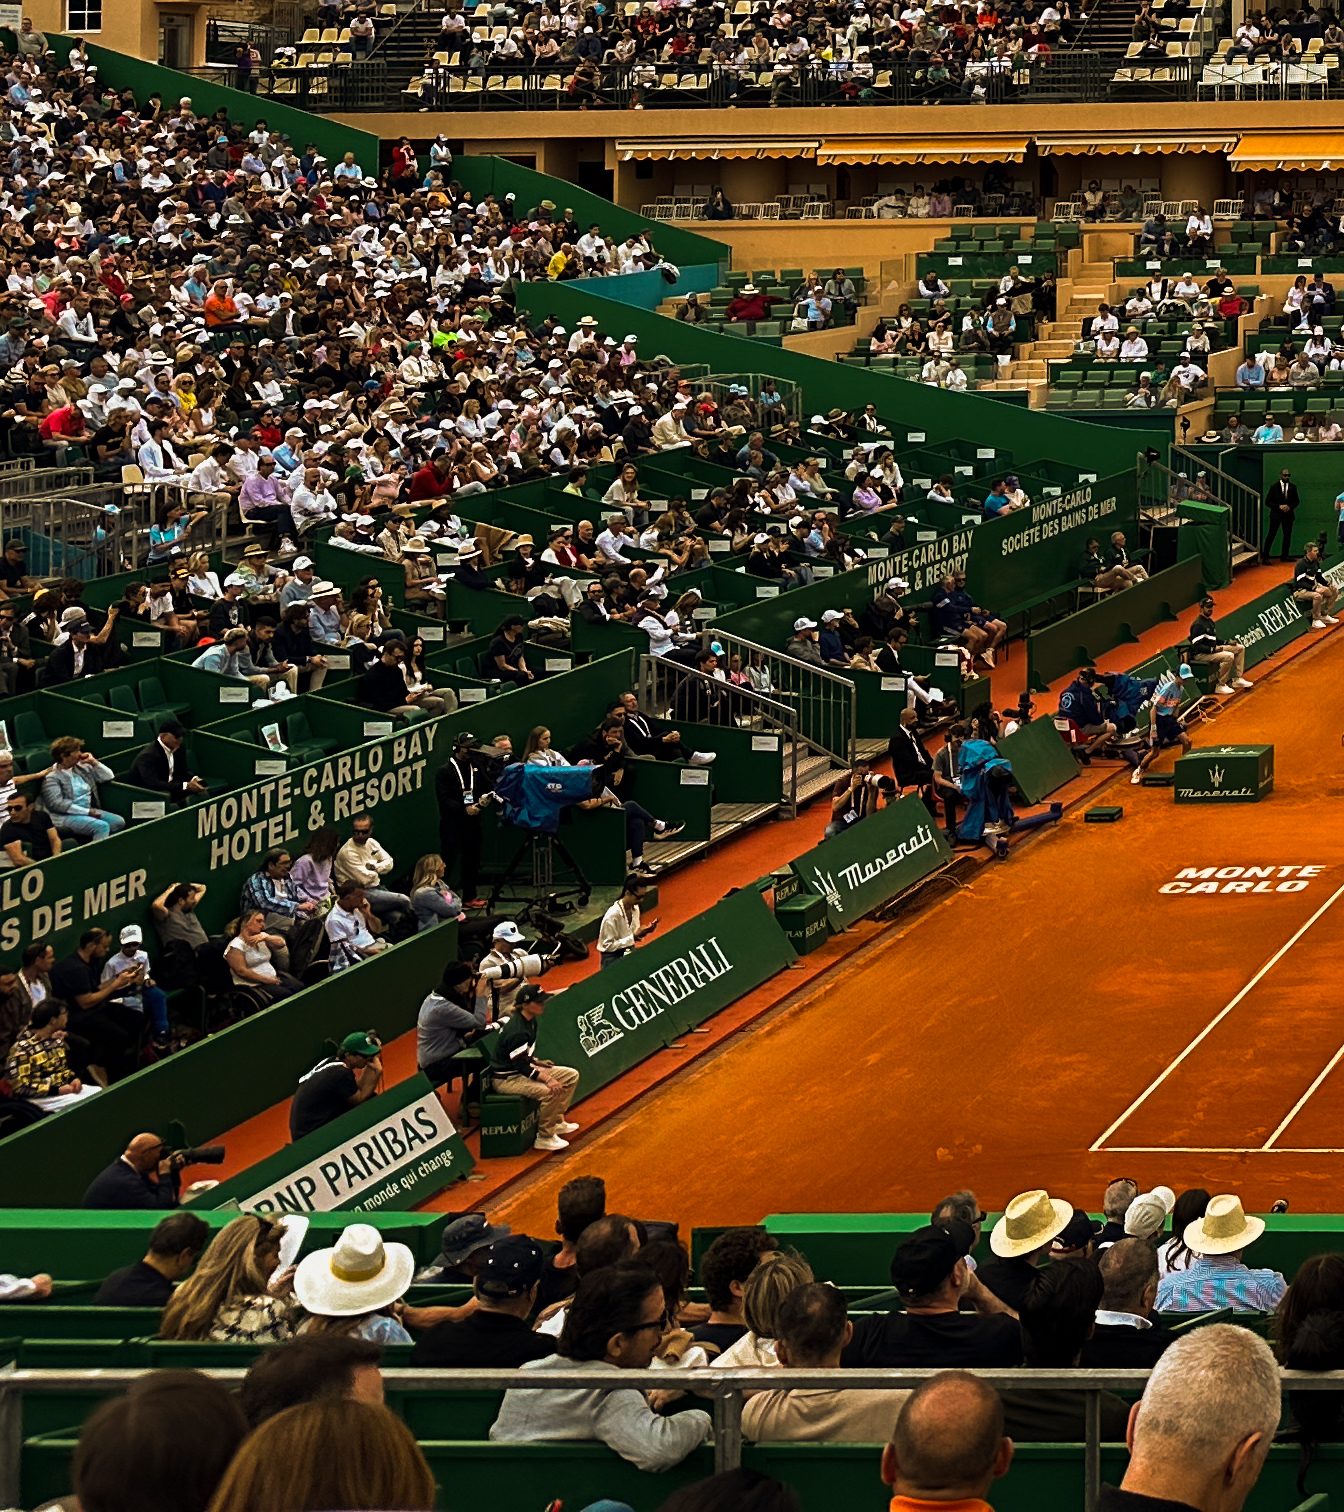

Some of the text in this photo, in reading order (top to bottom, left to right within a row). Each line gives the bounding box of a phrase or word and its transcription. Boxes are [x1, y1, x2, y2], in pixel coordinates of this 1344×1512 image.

[1002, 497, 1117, 555] SOCIÉTÉ DES BAINS DE MER
[1032, 487, 1092, 523] MONTE-CARLO
[868, 529, 974, 586] MONTE-CARLO BAY
[914, 571, 923, 591] &
[926, 553, 969, 587] RESORT
[1258, 595, 1303, 637] REPLAY
[197, 722, 439, 839] MONTE-CARLO BAY
[1177, 787, 1255, 799] Maserati
[209, 759, 428, 871] HOTEL & RESORT
[838, 824, 939, 890] Maserati
[1174, 864, 1327, 879] MONTE
[32, 895, 74, 941] DE
[83, 868, 148, 920] MER
[1158, 880, 1310, 894] CARLO
[805, 916, 827, 938] REPLAY
[611, 937, 734, 1031] GENERALI
[319, 1106, 439, 1197] PARIBAS
[481, 1124, 519, 1136] REPLAY
[363, 1182, 401, 1213] monde
[400, 1171, 419, 1193] qui
[417, 1148, 455, 1179] change
